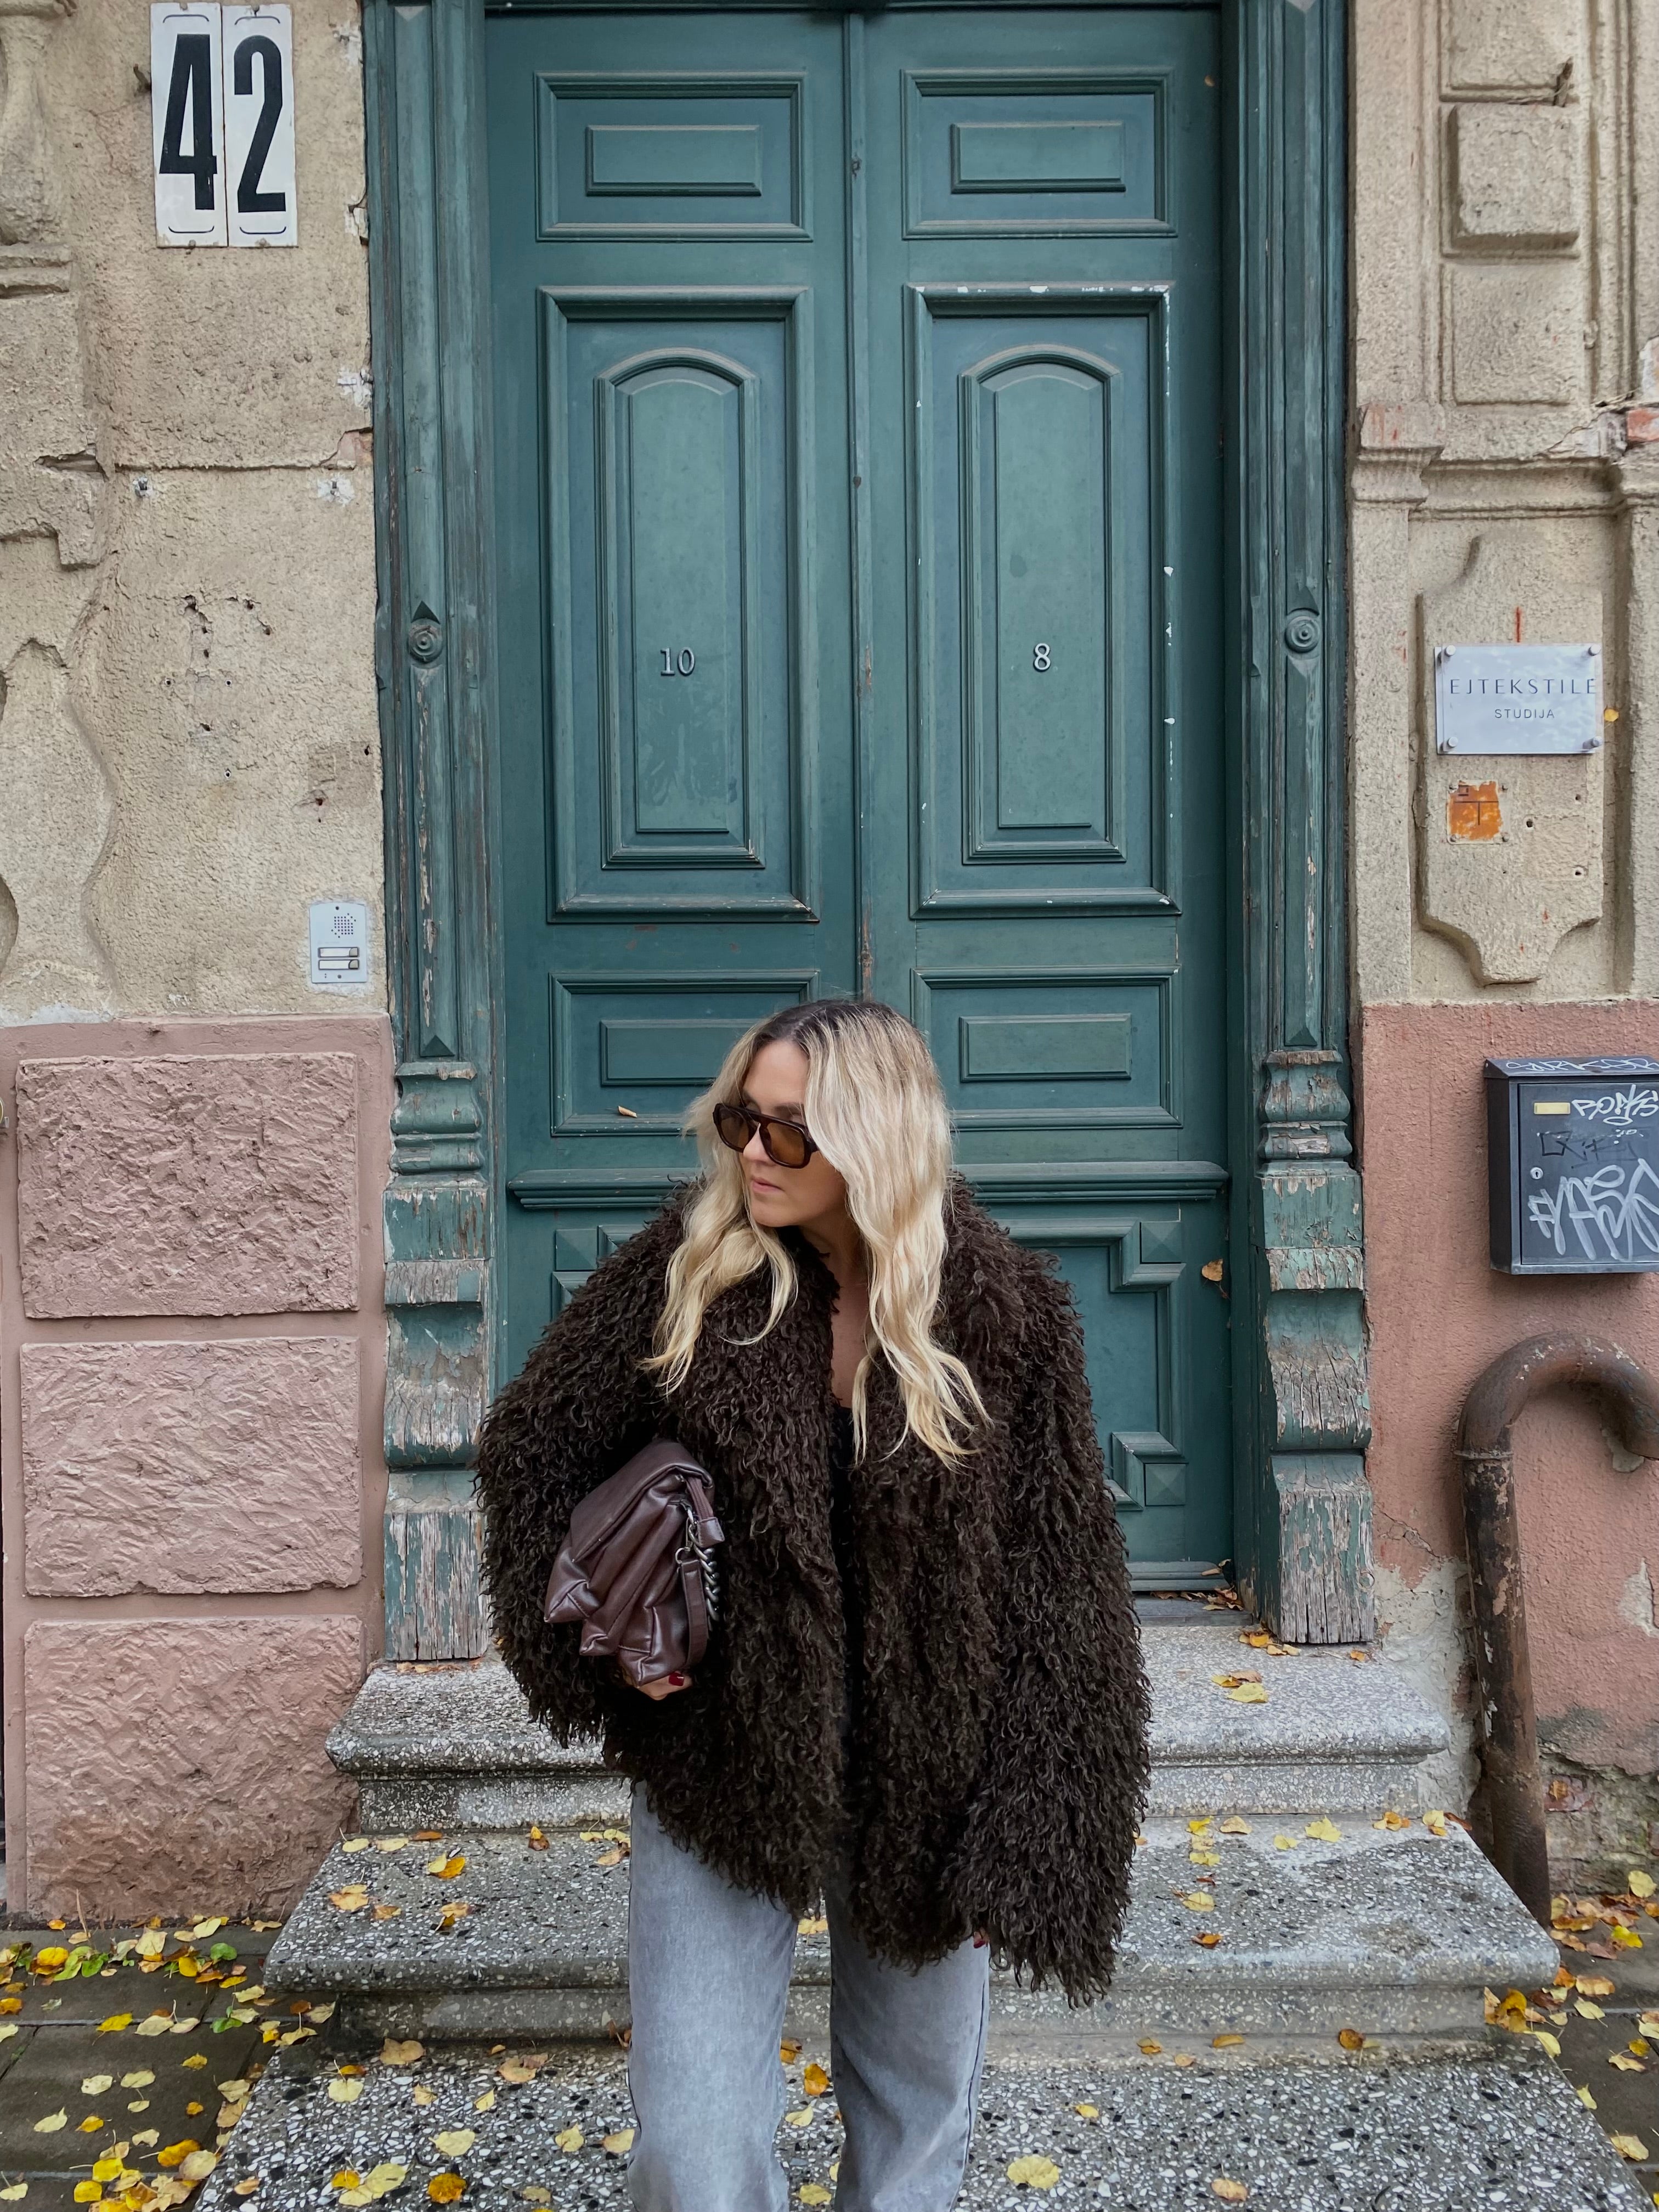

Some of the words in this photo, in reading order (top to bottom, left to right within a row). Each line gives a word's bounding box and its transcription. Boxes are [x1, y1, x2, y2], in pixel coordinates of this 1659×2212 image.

[159, 33, 286, 213] 42
[660, 647, 695, 676] 10
[1033, 643, 1051, 673] 8
[1450, 679, 1596, 695] EJTEKSTILE
[1494, 709, 1555, 719] STUDIJA
